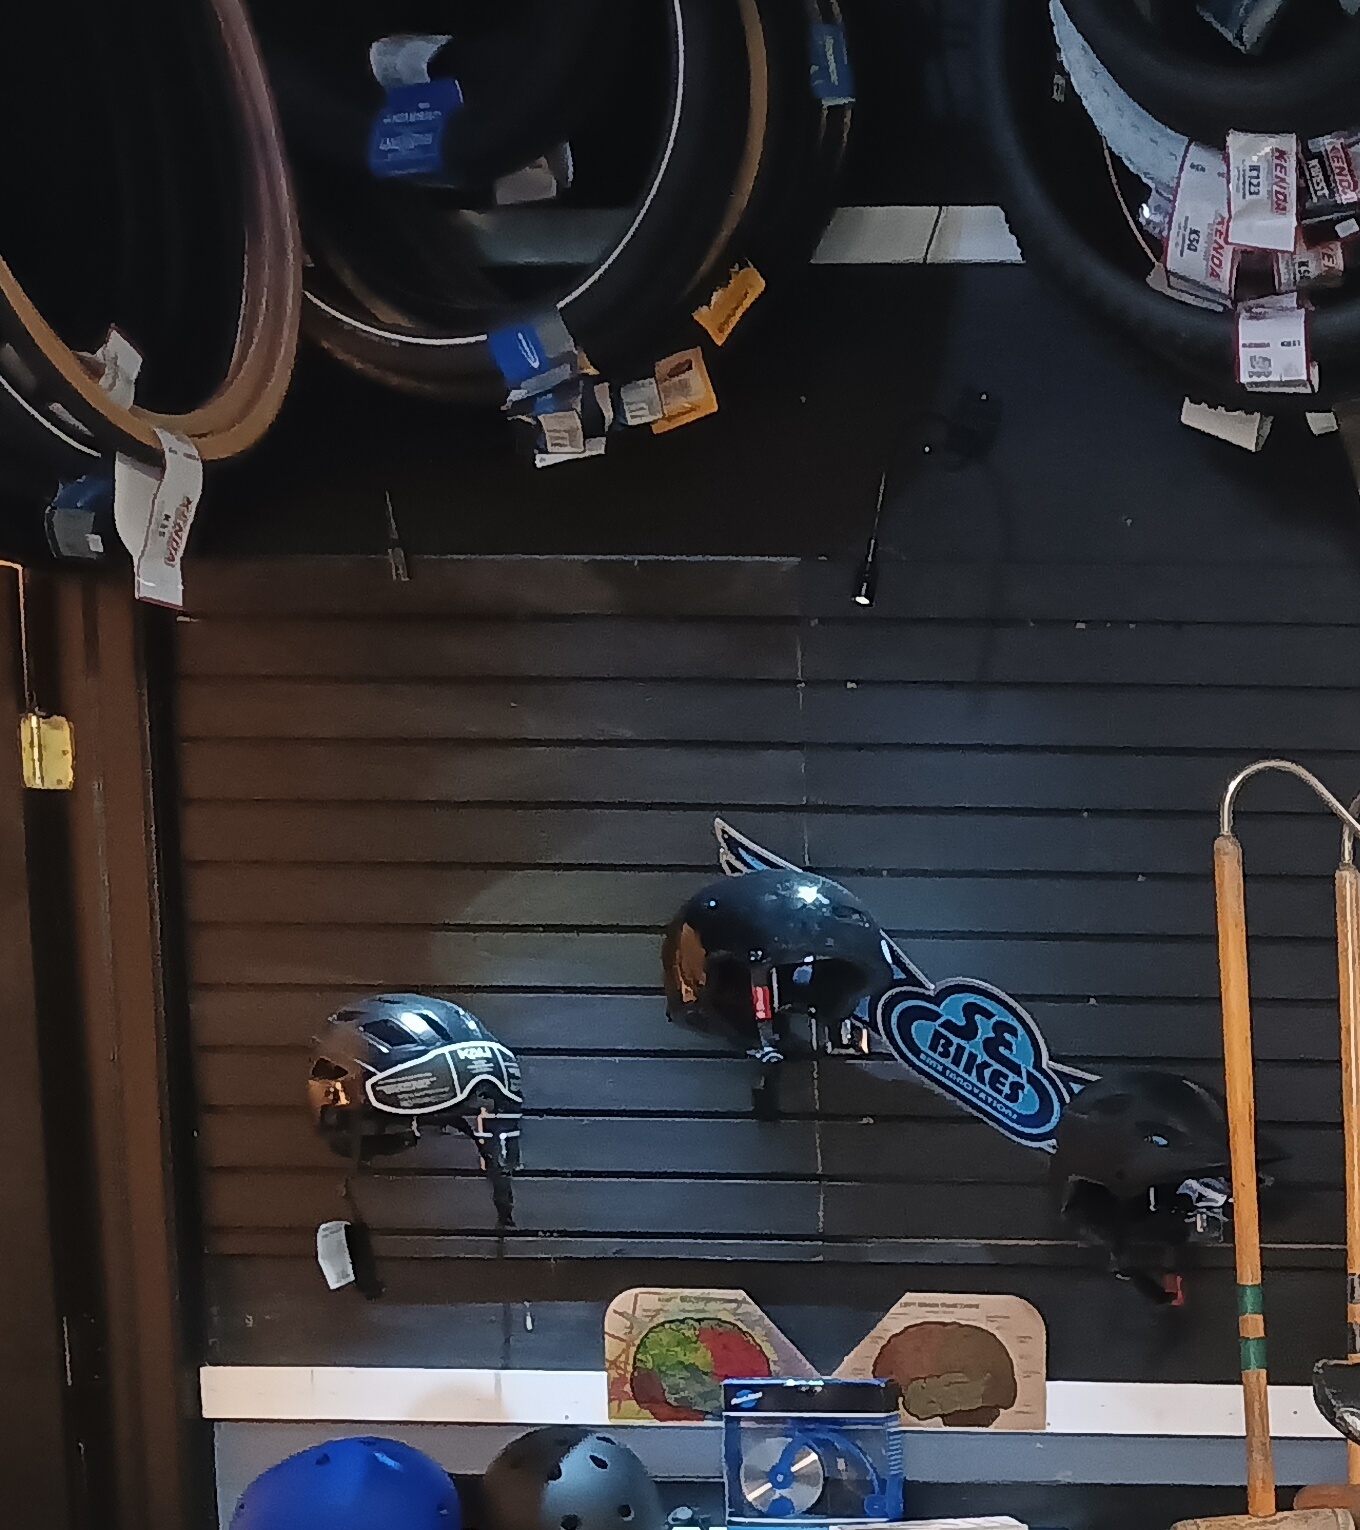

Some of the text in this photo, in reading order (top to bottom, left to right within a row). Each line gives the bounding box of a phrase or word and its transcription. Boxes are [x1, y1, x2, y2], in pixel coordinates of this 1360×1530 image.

[1248, 164, 1261, 196] K123
[1273, 146, 1289, 216] KENDA
[1209, 214, 1226, 282] KENDA
[927, 1028, 1027, 1104] BIKES
[937, 1001, 1024, 1079] SE
